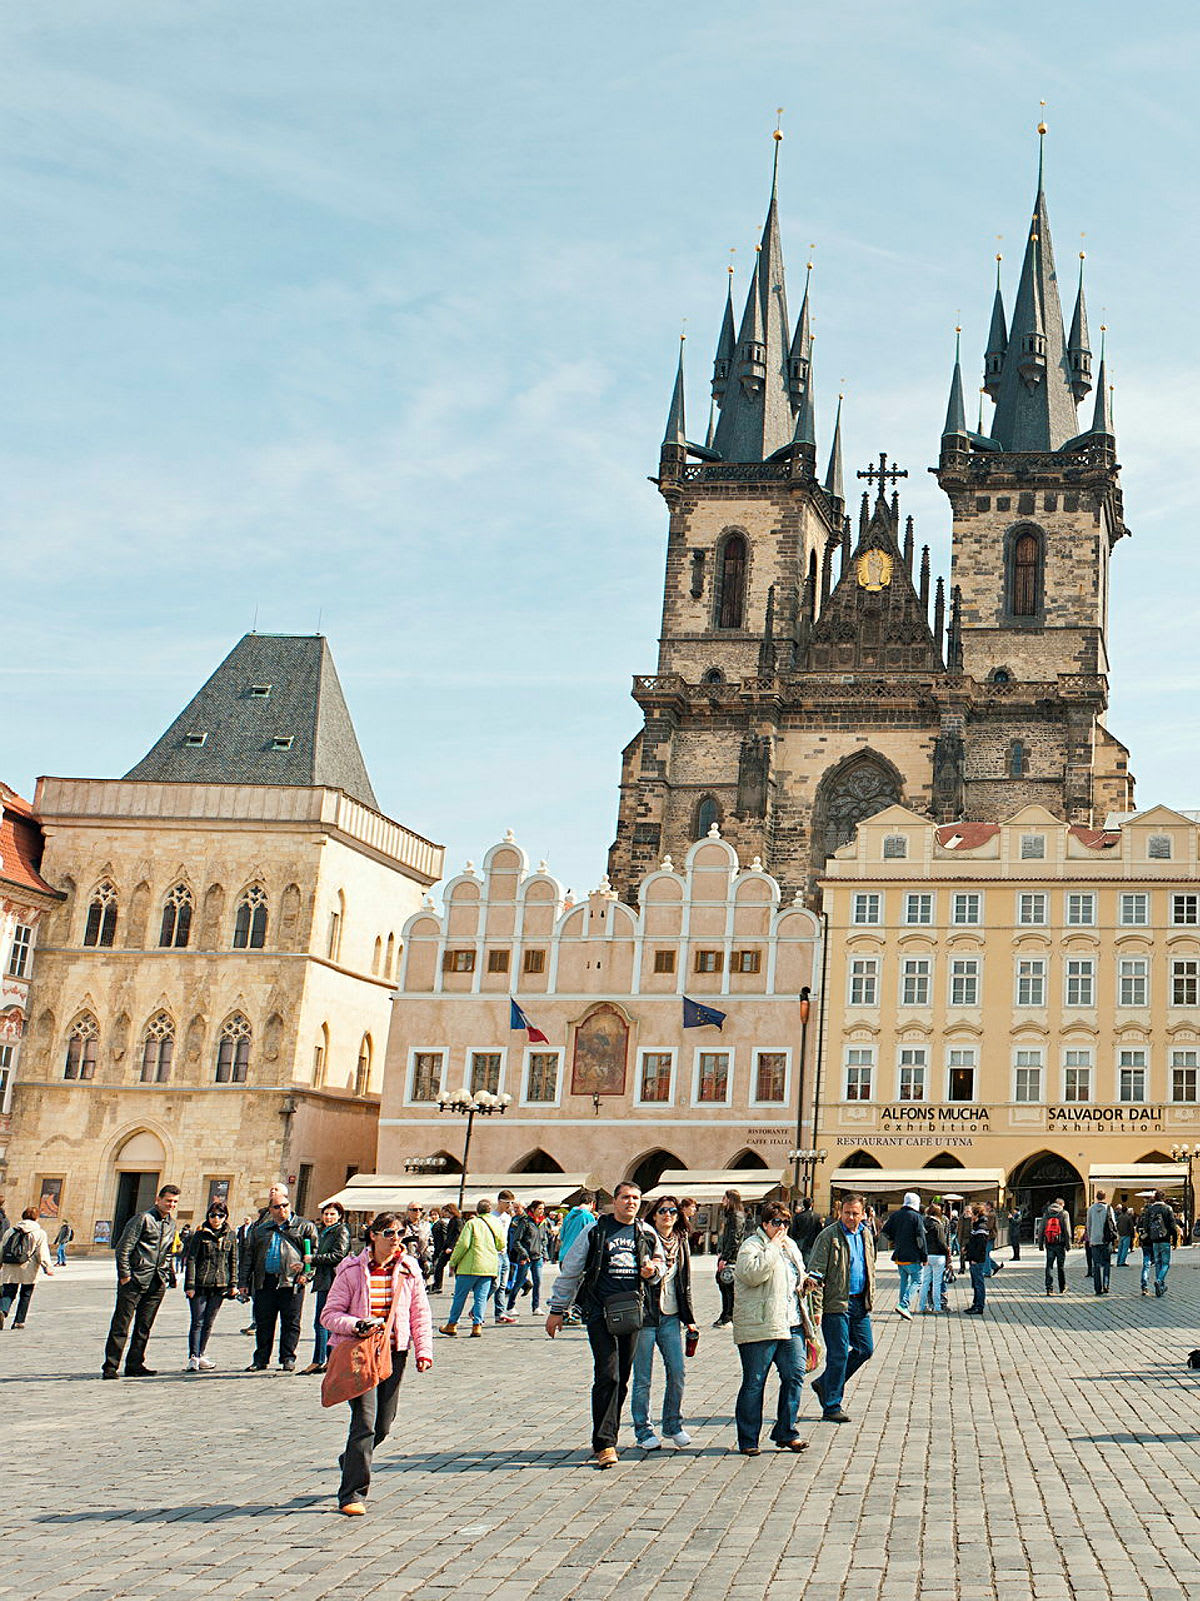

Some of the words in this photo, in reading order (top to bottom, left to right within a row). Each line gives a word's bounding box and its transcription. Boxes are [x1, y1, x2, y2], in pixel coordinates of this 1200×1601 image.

[881, 1107, 934, 1120] ALFONS
[938, 1107, 990, 1120] MUCHA
[1048, 1107, 1124, 1120] SALVADOR
[1129, 1105, 1162, 1120] DALÍ
[883, 1122, 990, 1132] exhibition
[1048, 1122, 1161, 1132] exhibition
[836, 1137, 903, 1146] RESTAURANT
[935, 1137, 943, 1146] U
